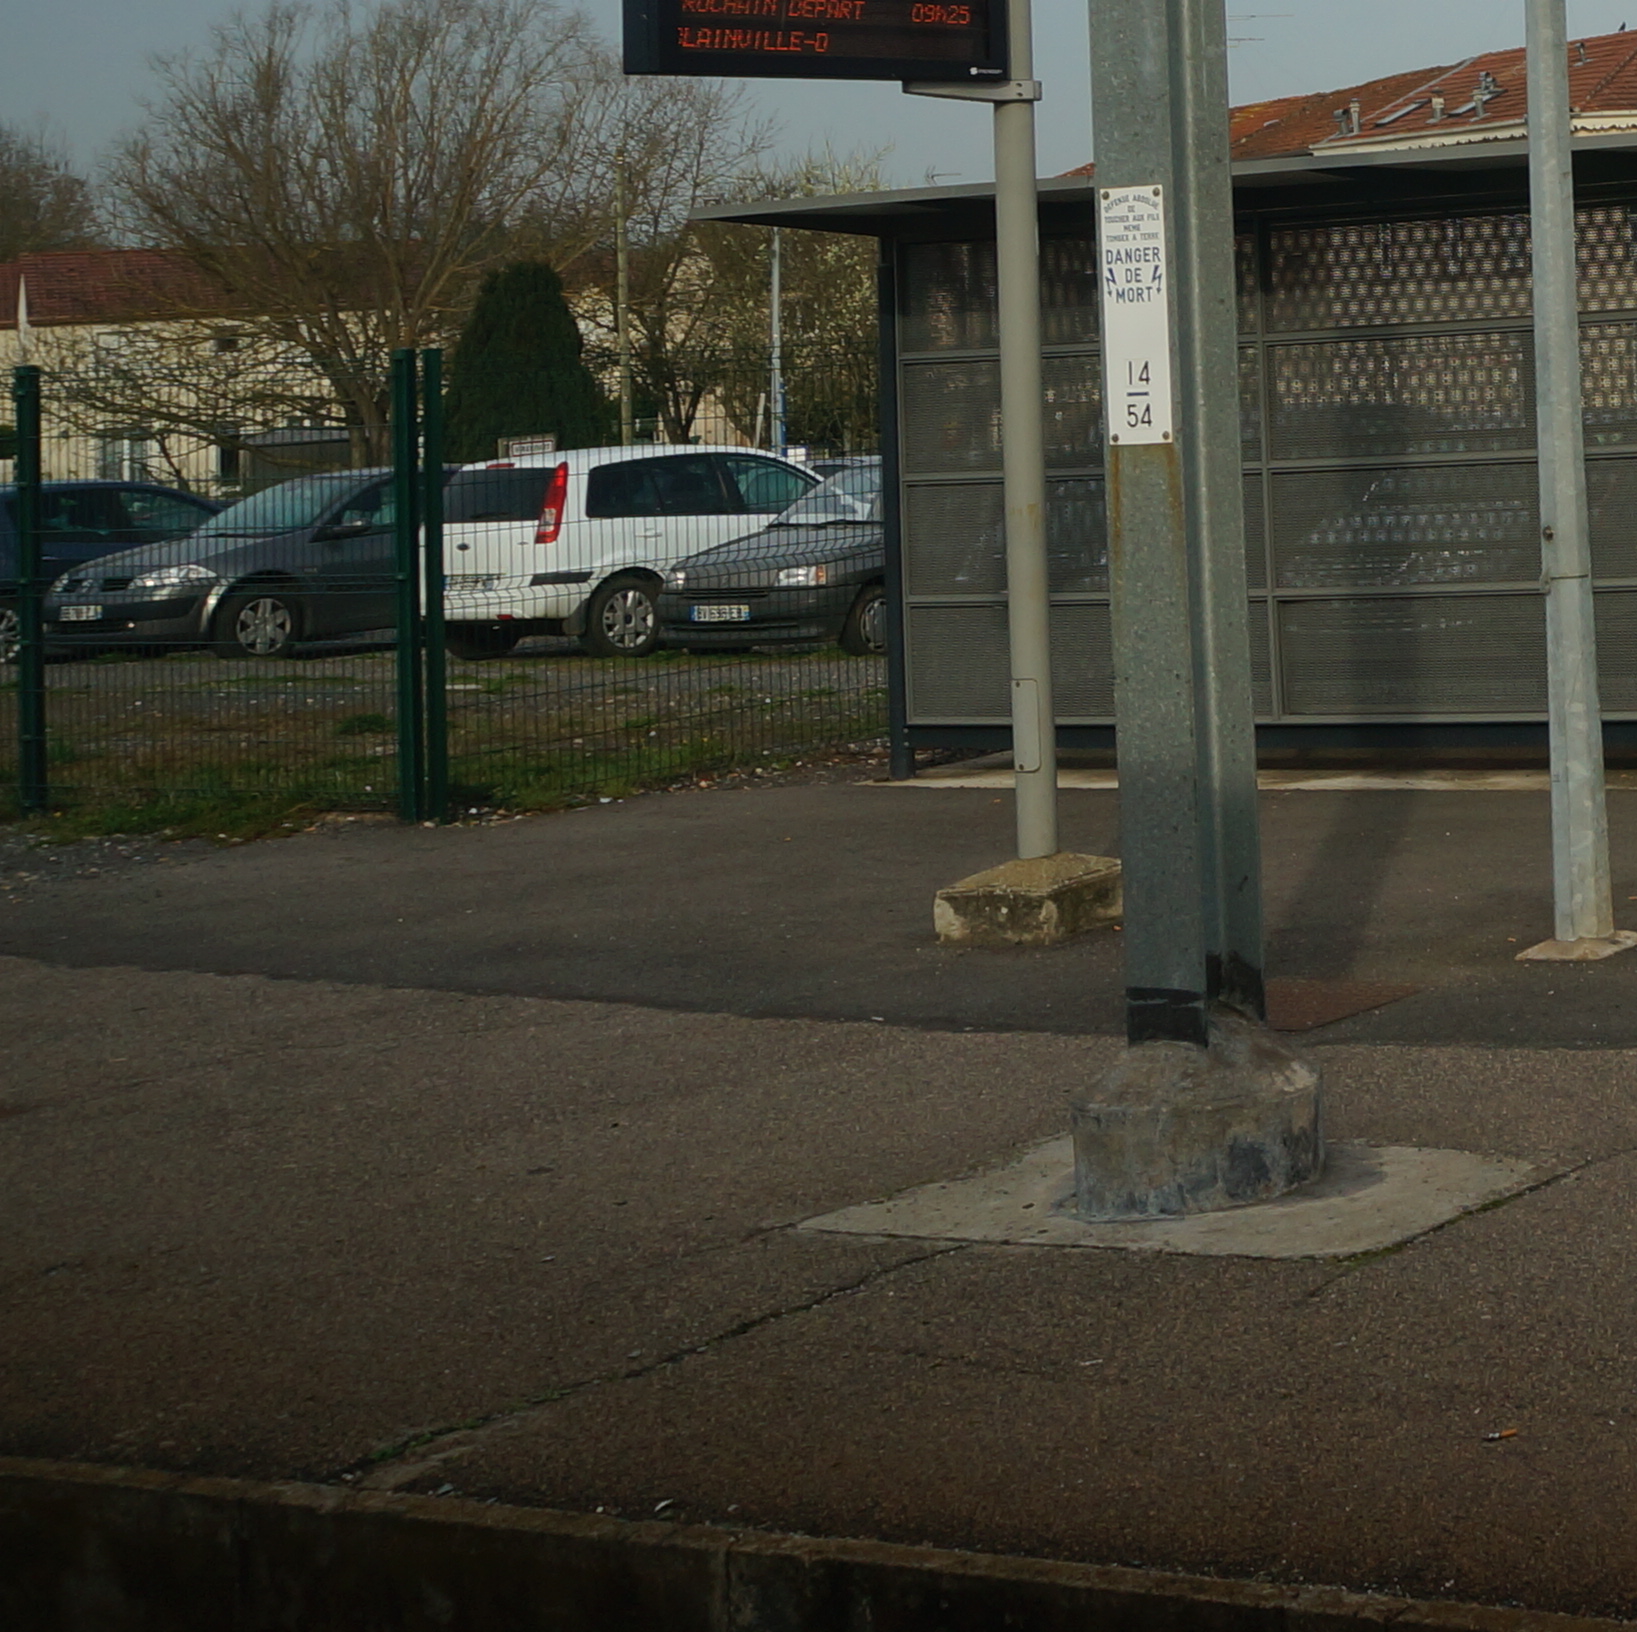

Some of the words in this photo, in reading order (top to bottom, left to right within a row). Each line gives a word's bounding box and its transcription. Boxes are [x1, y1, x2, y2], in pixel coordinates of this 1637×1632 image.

[911, 3, 971, 24] 09h25
[1106, 247, 1161, 265] DANGER
[1125, 268, 1142, 283] DE
[1116, 286, 1153, 304] MORT
[1128, 361, 1150, 385] 14
[1127, 403, 1152, 428] 54
